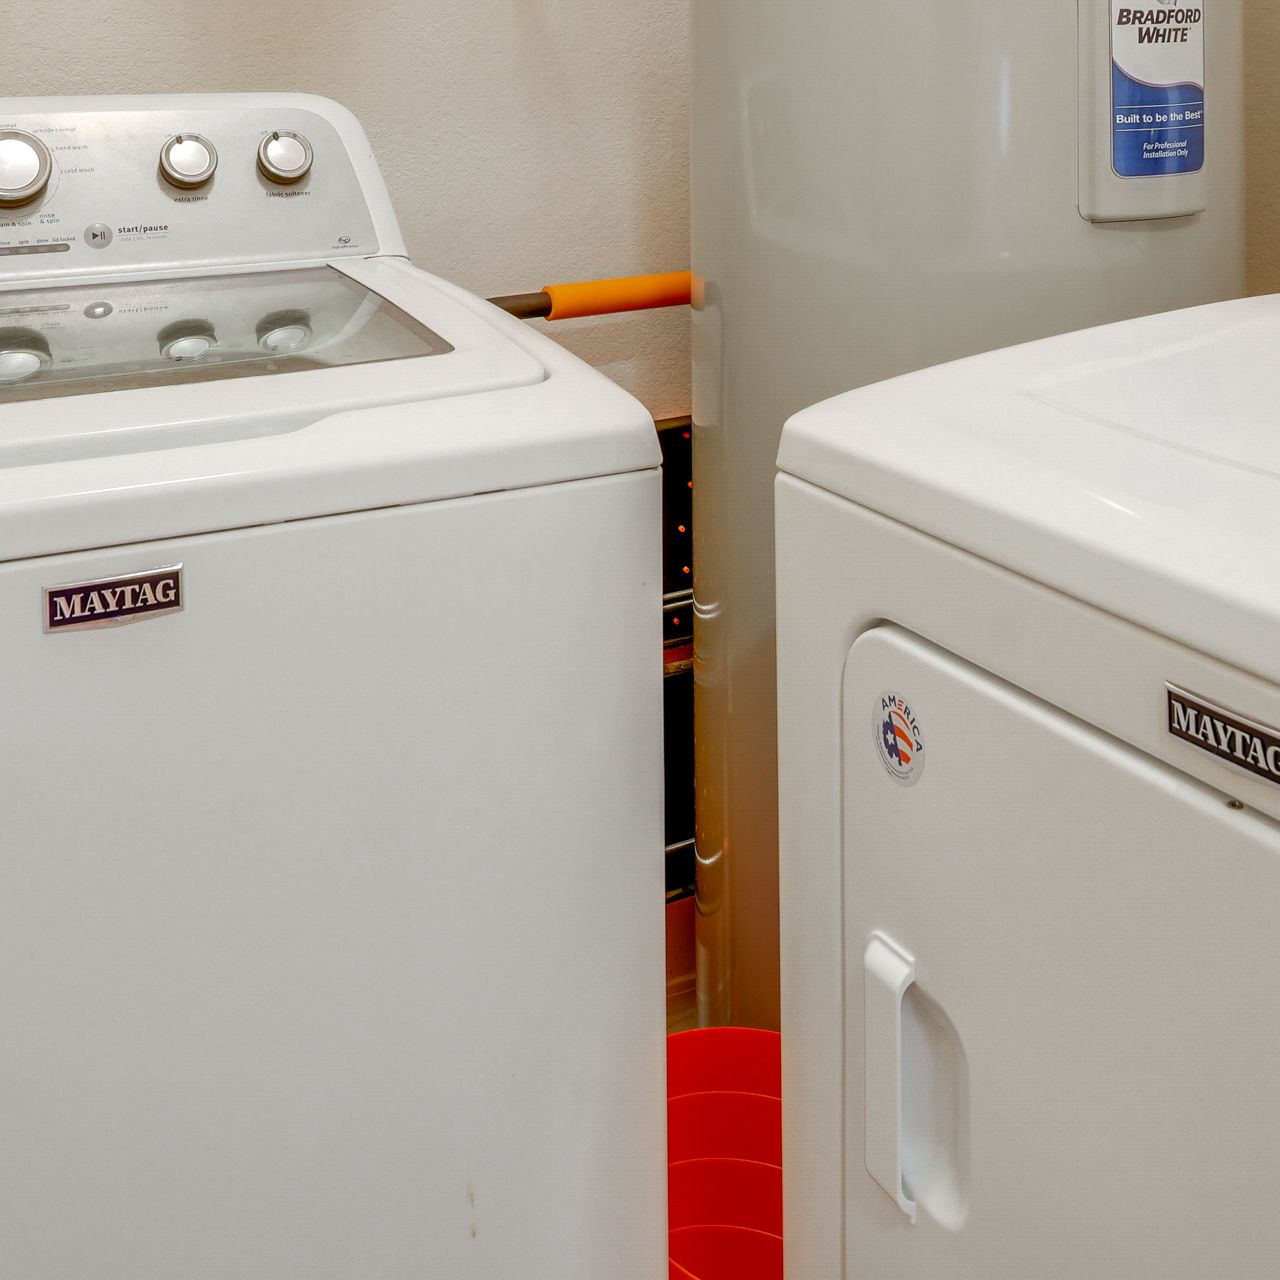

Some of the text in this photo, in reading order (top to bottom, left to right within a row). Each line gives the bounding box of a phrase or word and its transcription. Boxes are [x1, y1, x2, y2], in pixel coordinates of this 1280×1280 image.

[1117, 8, 1201, 26] BRADFORD
[1138, 27, 1188, 44] WHITE
[1116, 111, 1201, 124] Built to be the Best
[1143, 140, 1187, 150] For Professional
[1143, 149, 1188, 159] Installation Only
[46, 218, 60, 226] spin
[117, 223, 169, 235] start/pause
[54, 579, 177, 621] MAYTAG
[881, 694, 923, 753] AMERICA
